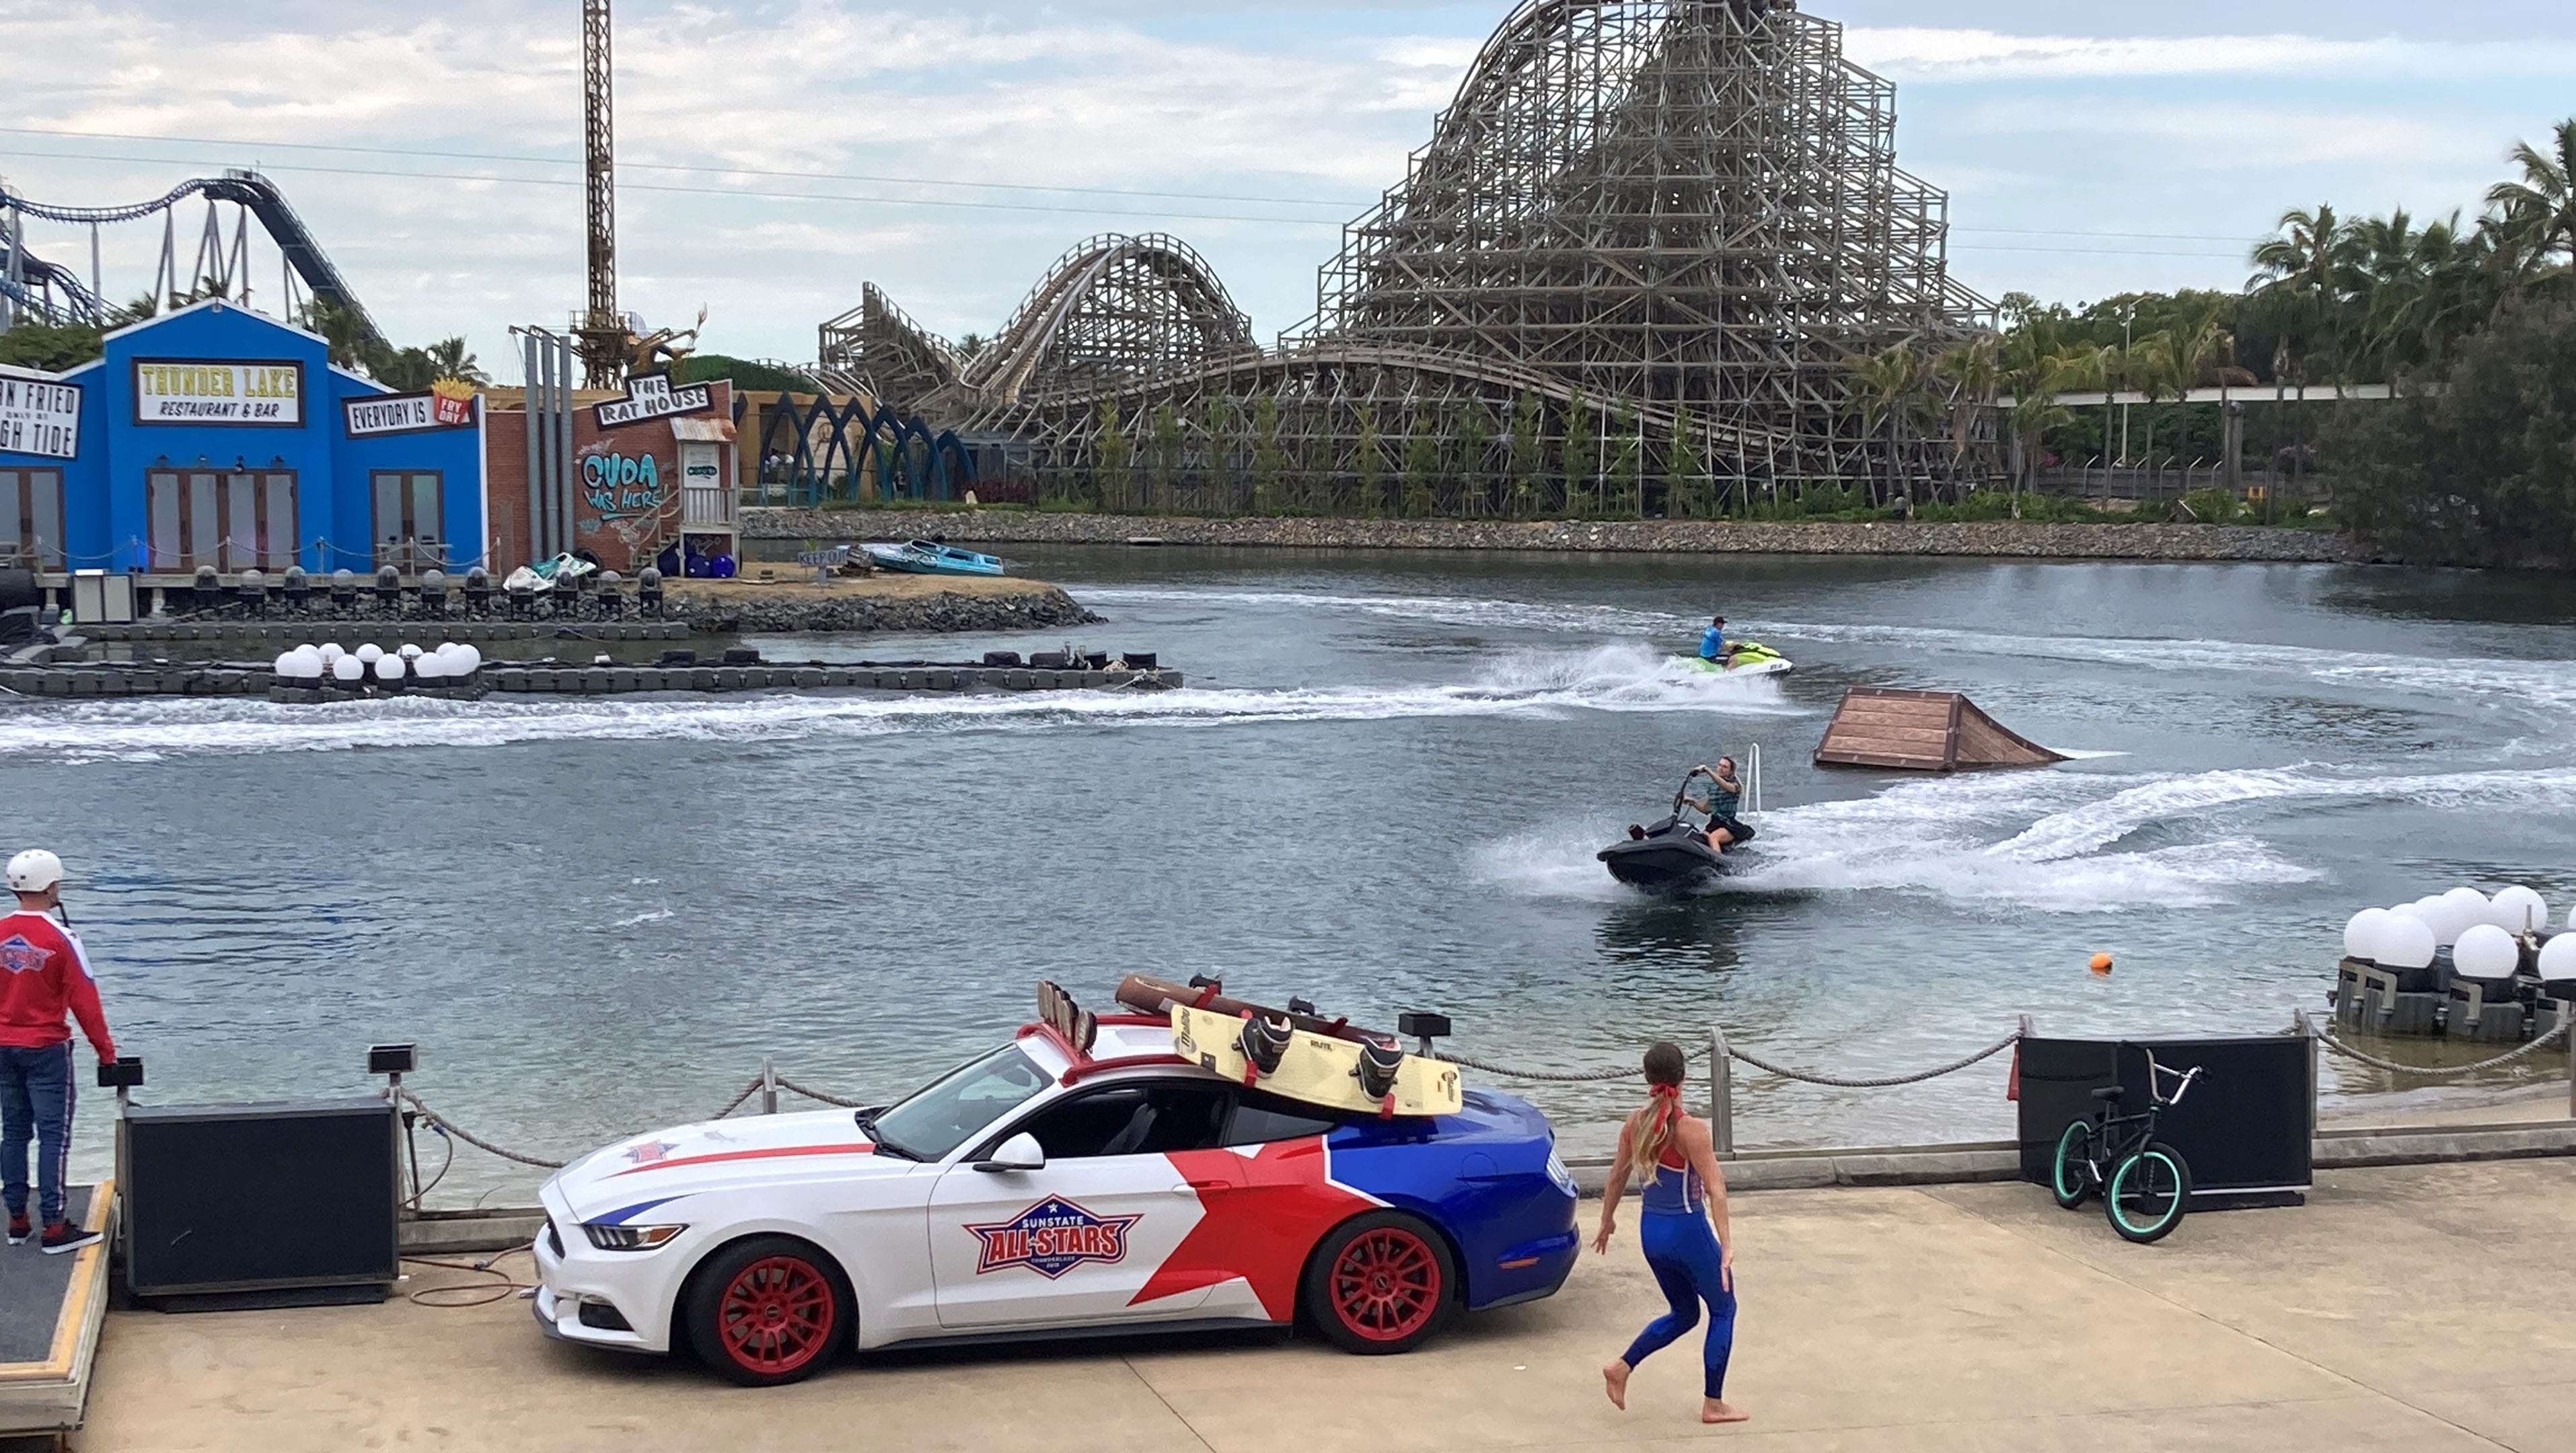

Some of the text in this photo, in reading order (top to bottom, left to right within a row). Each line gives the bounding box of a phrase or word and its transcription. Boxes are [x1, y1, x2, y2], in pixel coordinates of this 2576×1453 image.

[142, 366, 295, 398] THUNDER LAKE
[632, 379, 666, 395] THE
[25, 384, 75, 414] FRIED
[441, 398, 462, 413] FRY
[601, 386, 706, 421] RAT HOUSE
[159, 401, 280, 418] RESTAURANT & BAR
[353, 401, 426, 429] EVERYDAY IS
[439, 410, 460, 423] DAY
[34, 423, 71, 455] TIDE
[800, 552, 826, 564] KEEP
[1022, 1216, 1084, 1229] SUNSTATE
